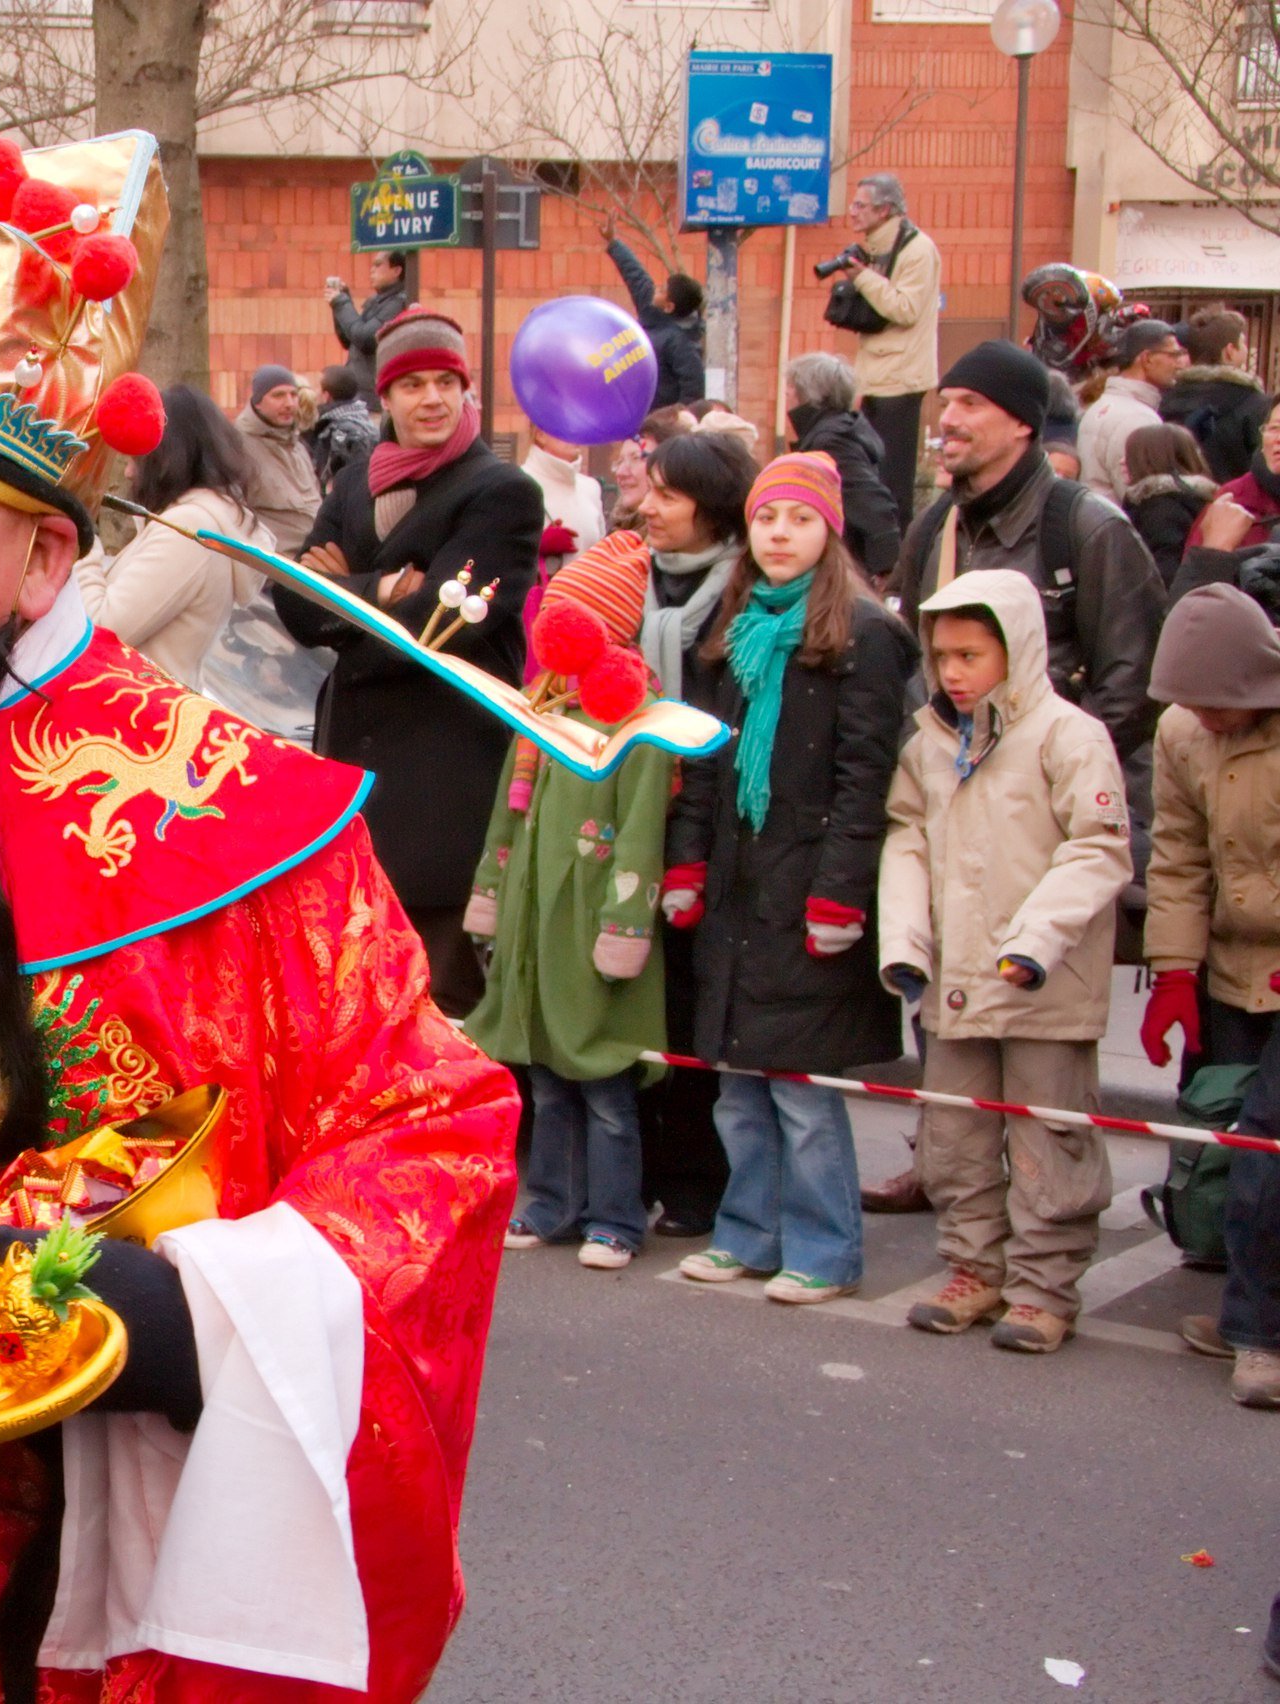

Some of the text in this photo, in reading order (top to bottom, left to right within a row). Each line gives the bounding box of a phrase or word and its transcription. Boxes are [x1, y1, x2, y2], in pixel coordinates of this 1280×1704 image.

[720, 64, 731, 72] DE
[746, 157, 821, 170] BAUDRICOURT
[372, 190, 440, 213] AVENUE
